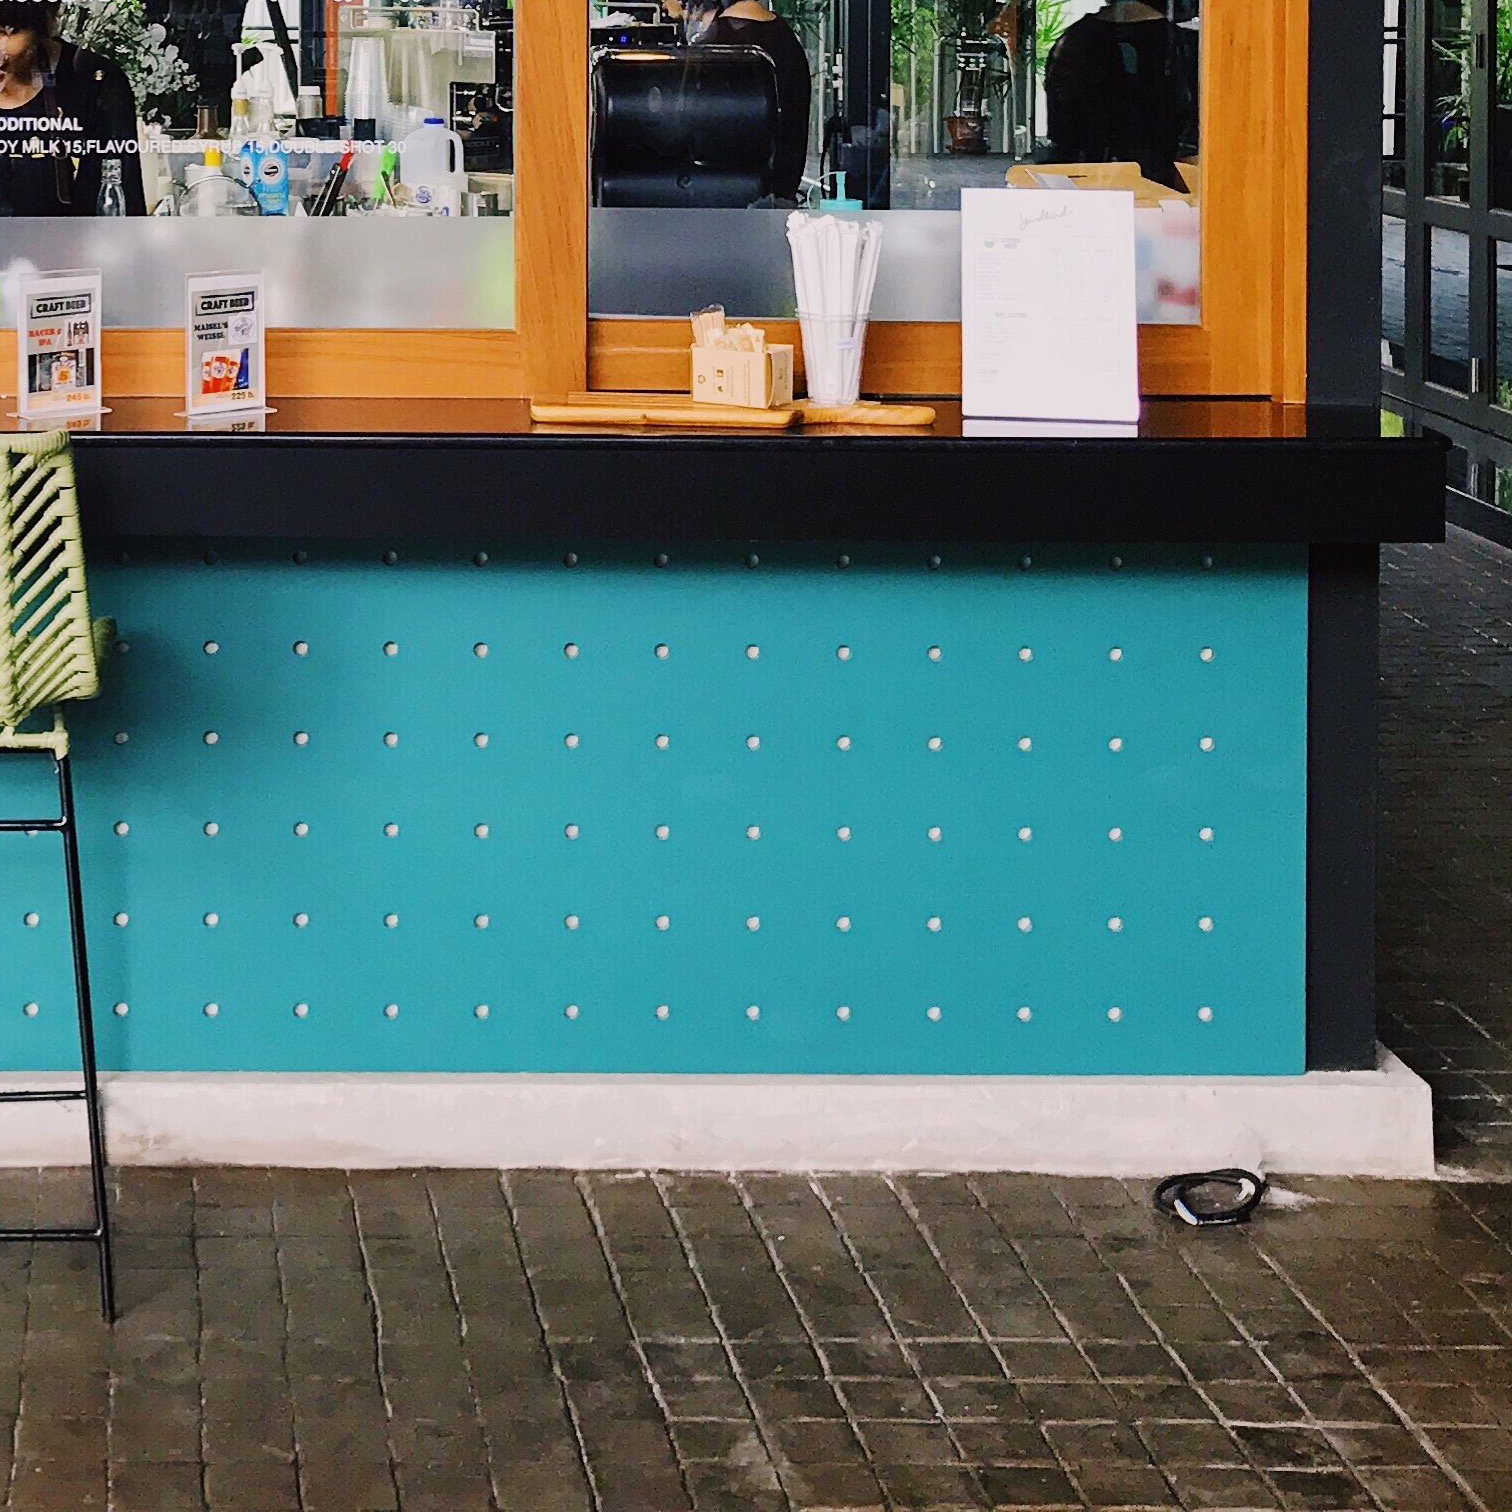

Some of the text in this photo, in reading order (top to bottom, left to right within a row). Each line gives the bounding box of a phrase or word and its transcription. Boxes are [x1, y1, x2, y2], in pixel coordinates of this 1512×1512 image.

[22, 139, 60, 154] MILK
[388, 139, 407, 155] 30
[36, 301, 64, 314] CRAFT
[200, 299, 228, 311] CRAFT
